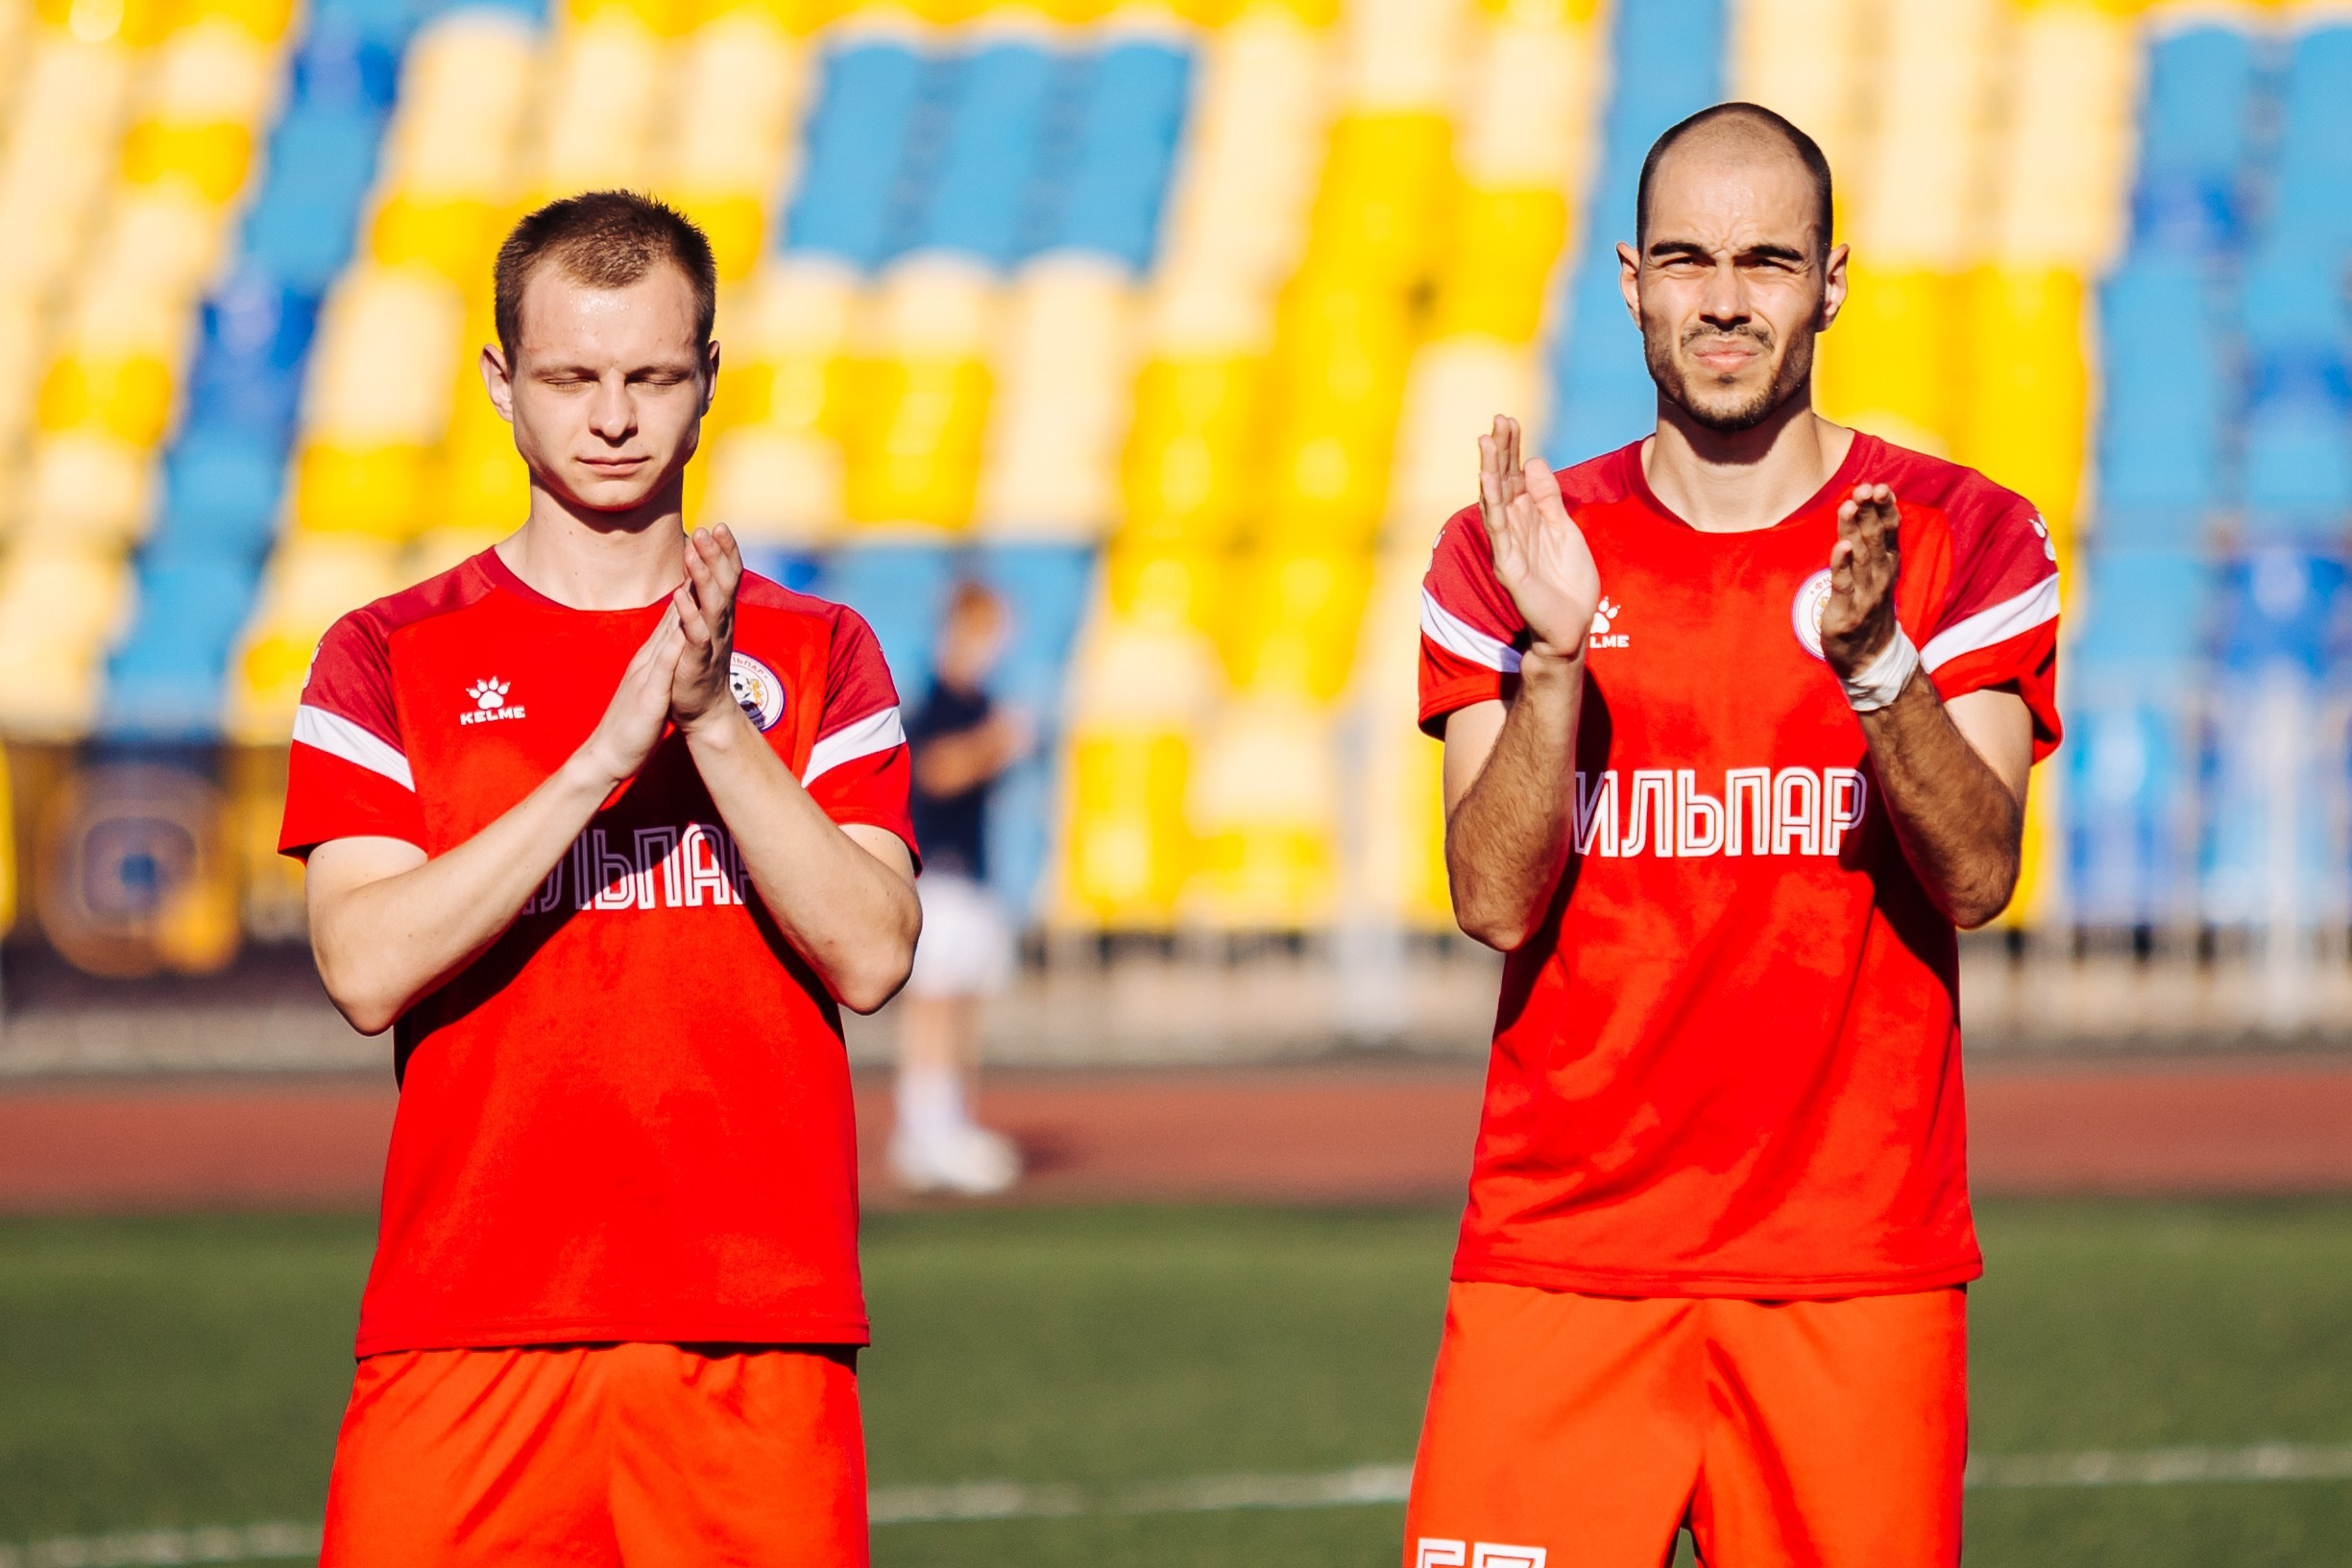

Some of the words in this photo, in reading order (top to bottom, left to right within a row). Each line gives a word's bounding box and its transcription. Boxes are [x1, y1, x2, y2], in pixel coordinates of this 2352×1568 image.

[1589, 635, 1630, 649] LME
[460, 705, 526, 725] KELME
[1572, 766, 1867, 857] ИЛЬПАР
